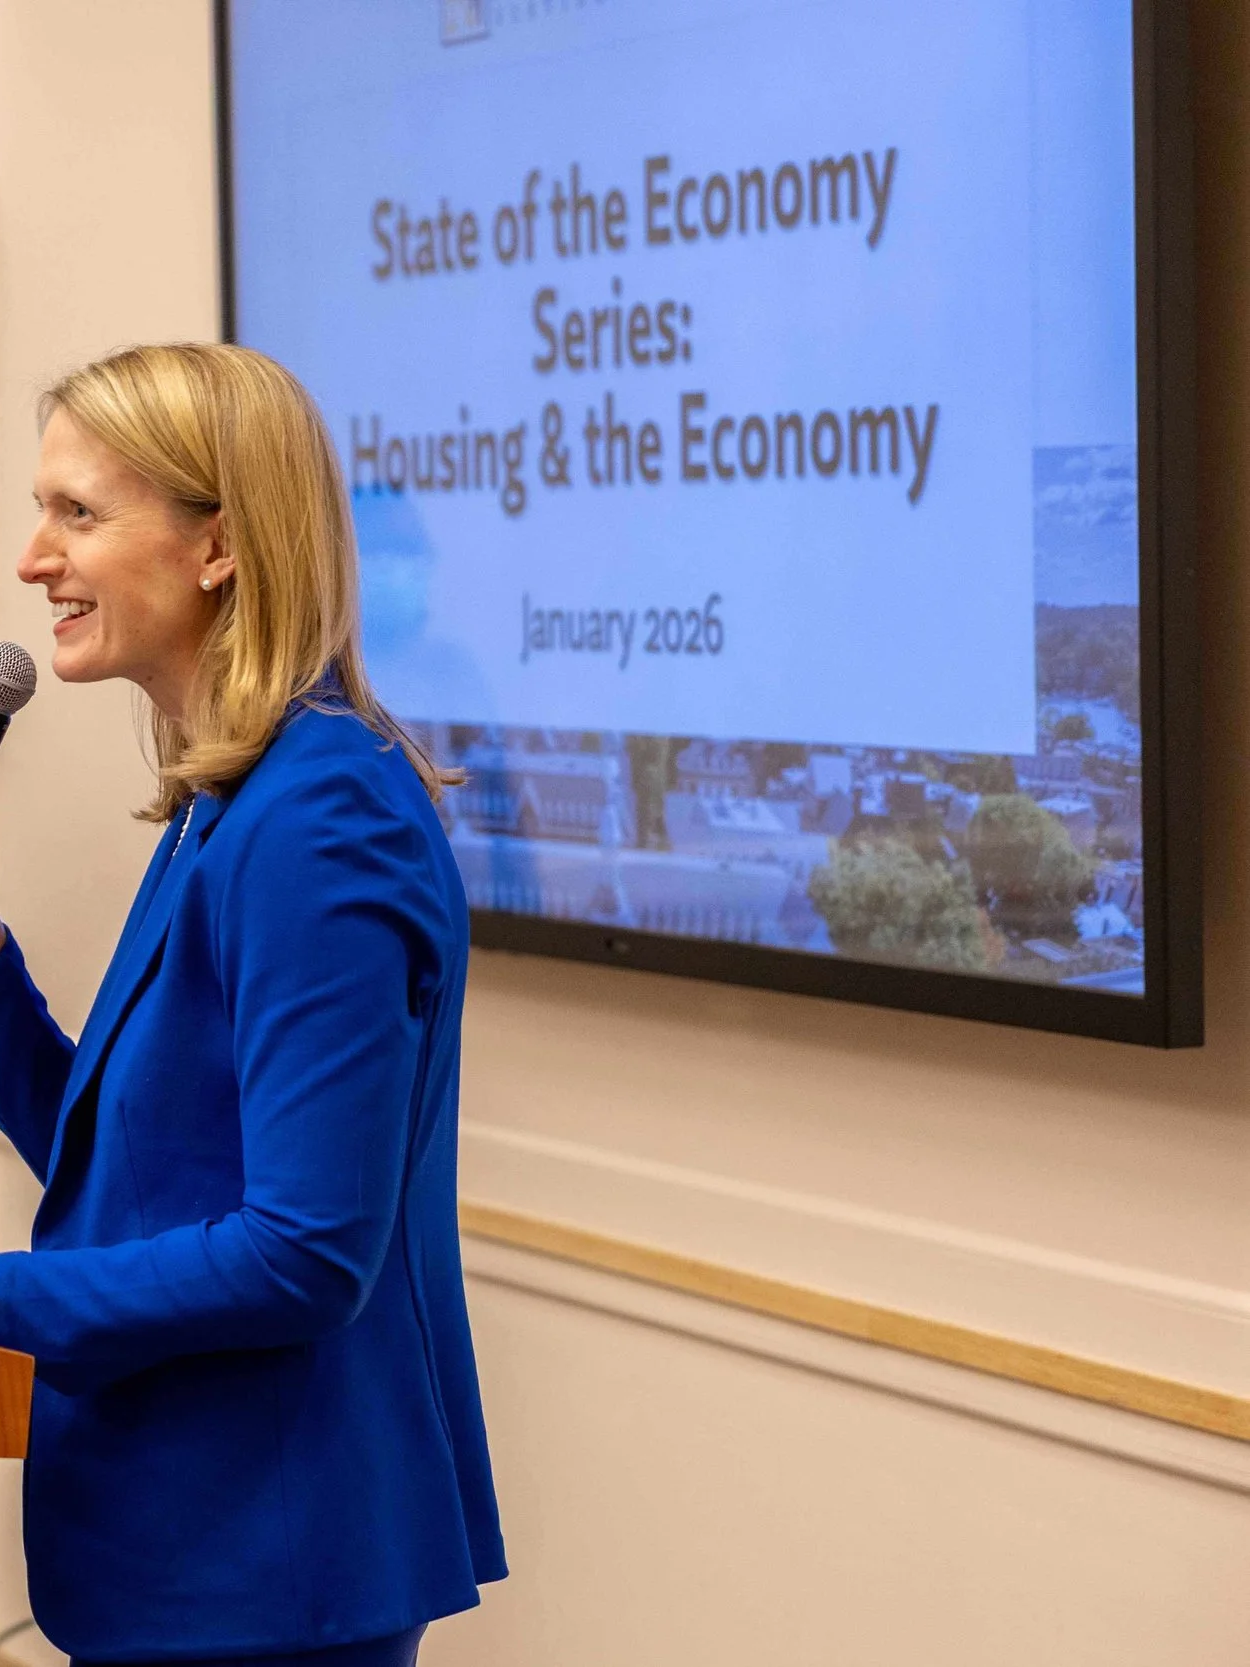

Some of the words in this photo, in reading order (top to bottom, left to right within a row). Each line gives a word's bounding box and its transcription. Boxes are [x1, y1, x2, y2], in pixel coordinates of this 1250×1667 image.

[371, 198, 479, 281] State
[494, 169, 541, 265] of
[549, 162, 627, 258] the
[644, 146, 898, 250] Economy
[533, 276, 692, 374] Series:
[350, 404, 526, 518] Housing
[539, 401, 571, 488] &
[583, 392, 662, 486] the
[680, 391, 940, 506] Economy
[520, 593, 636, 670] January
[644, 592, 725, 656] 2026
